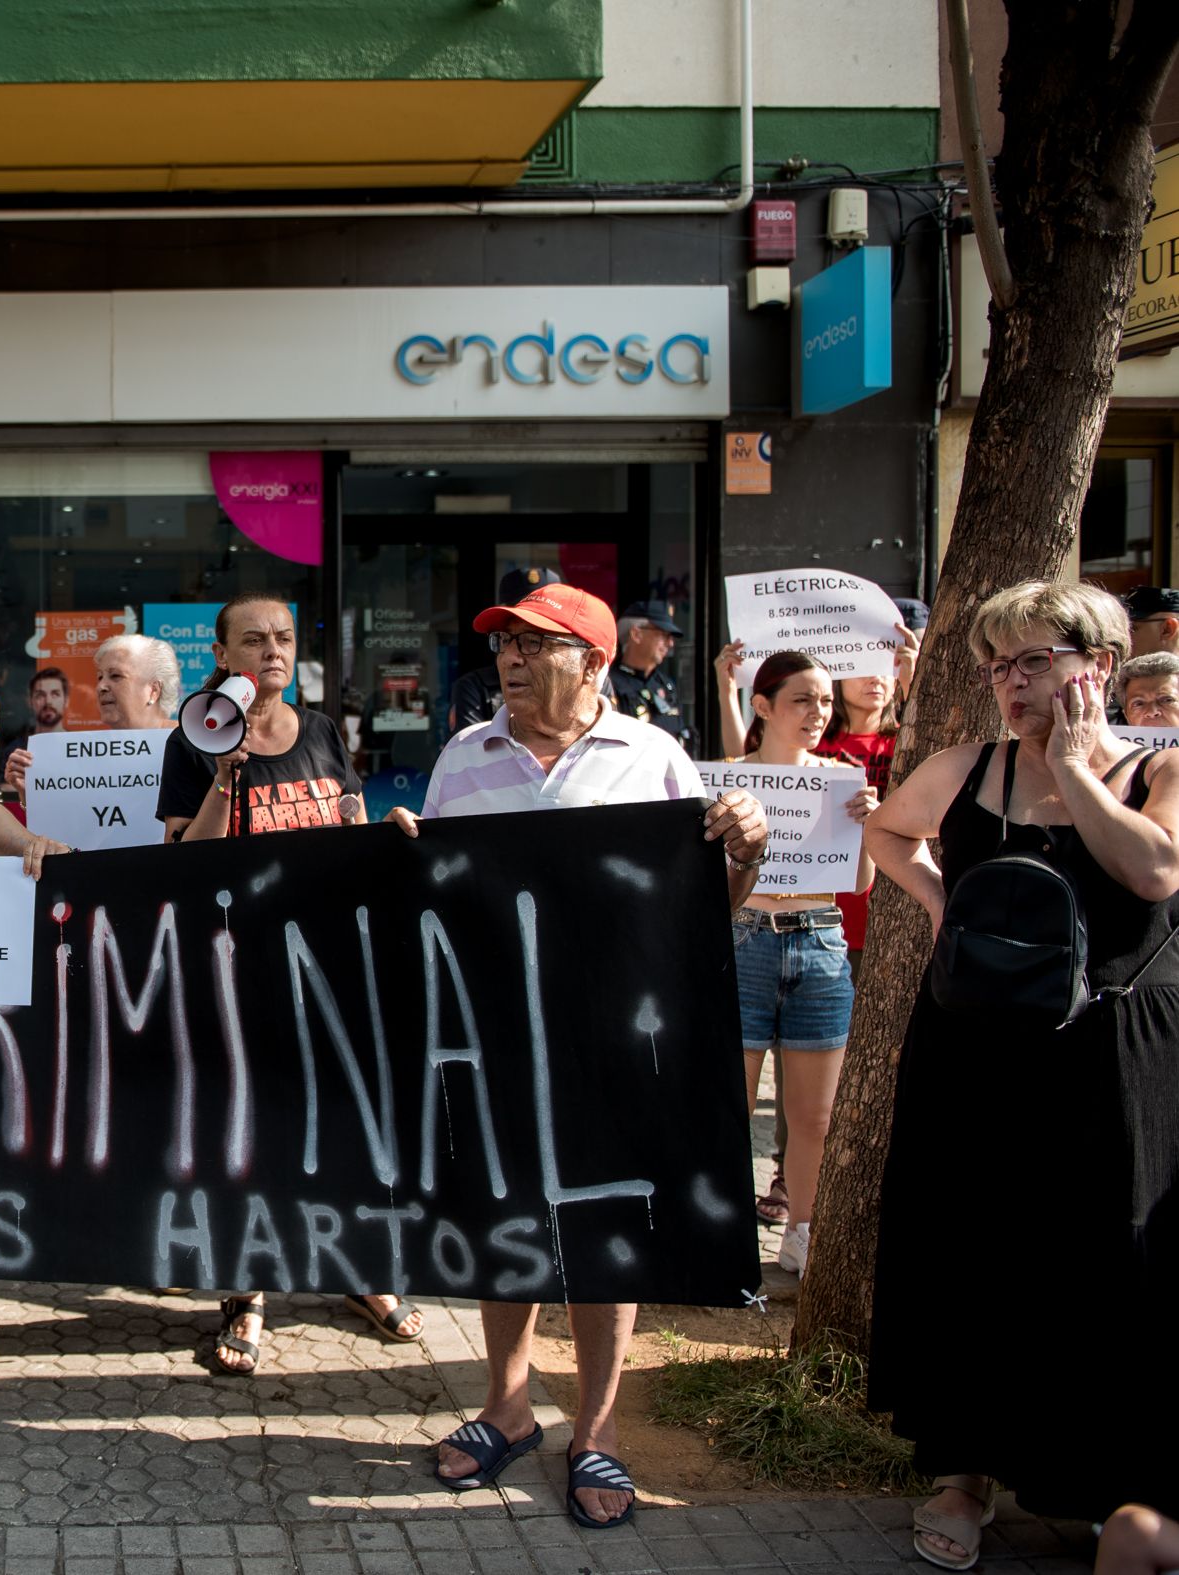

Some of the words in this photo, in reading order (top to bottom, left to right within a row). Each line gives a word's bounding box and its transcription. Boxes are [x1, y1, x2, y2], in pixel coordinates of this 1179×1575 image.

[757, 210, 793, 220] FUEGO
[804, 314, 858, 360] endesa
[395, 318, 712, 386] endesa
[754, 577, 864, 596] ELÉCTRICAS:
[769, 607, 799, 619] 8.529
[803, 603, 856, 616] millones
[66, 628, 98, 645] gas
[159, 624, 193, 638] Con
[777, 627, 790, 639] de
[794, 624, 850, 637] beneficio
[364, 636, 422, 649] endesa
[867, 640, 897, 651] CON
[66, 740, 152, 758] ENDESA
[35, 774, 161, 791] NACIONALIZACI
[700, 770, 828, 792] ELÉCTRICAS:
[277, 780, 310, 803] DE
[310, 778, 342, 799] UN
[92, 806, 127, 827] YA
[765, 806, 811, 818] illones
[817, 853, 849, 864] CON
[154, 1190, 550, 1296] HARTOS
